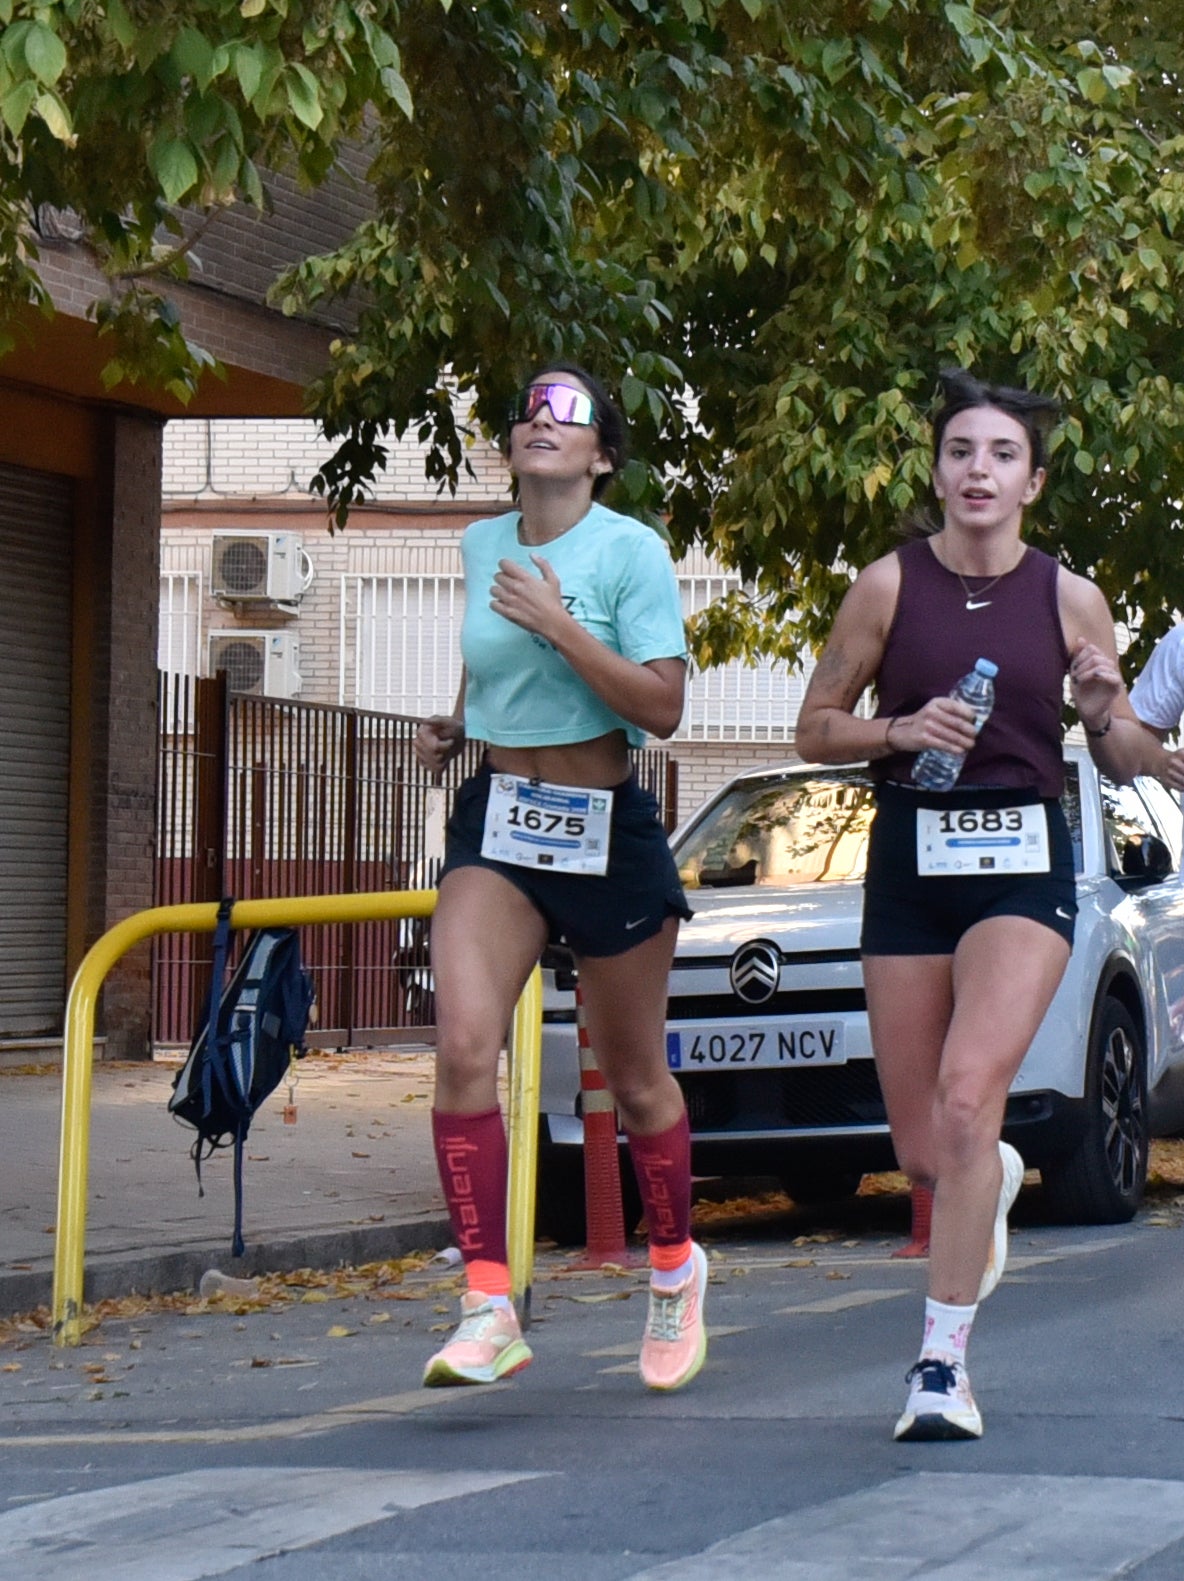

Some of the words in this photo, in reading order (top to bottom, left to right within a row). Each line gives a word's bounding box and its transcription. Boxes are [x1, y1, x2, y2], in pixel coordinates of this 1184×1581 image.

[507, 805, 585, 836] 1675
[939, 809, 1022, 833] 1683
[690, 1032, 765, 1063] 4027
[778, 1029, 835, 1060] NCV
[441, 1136, 482, 1250] kalenji
